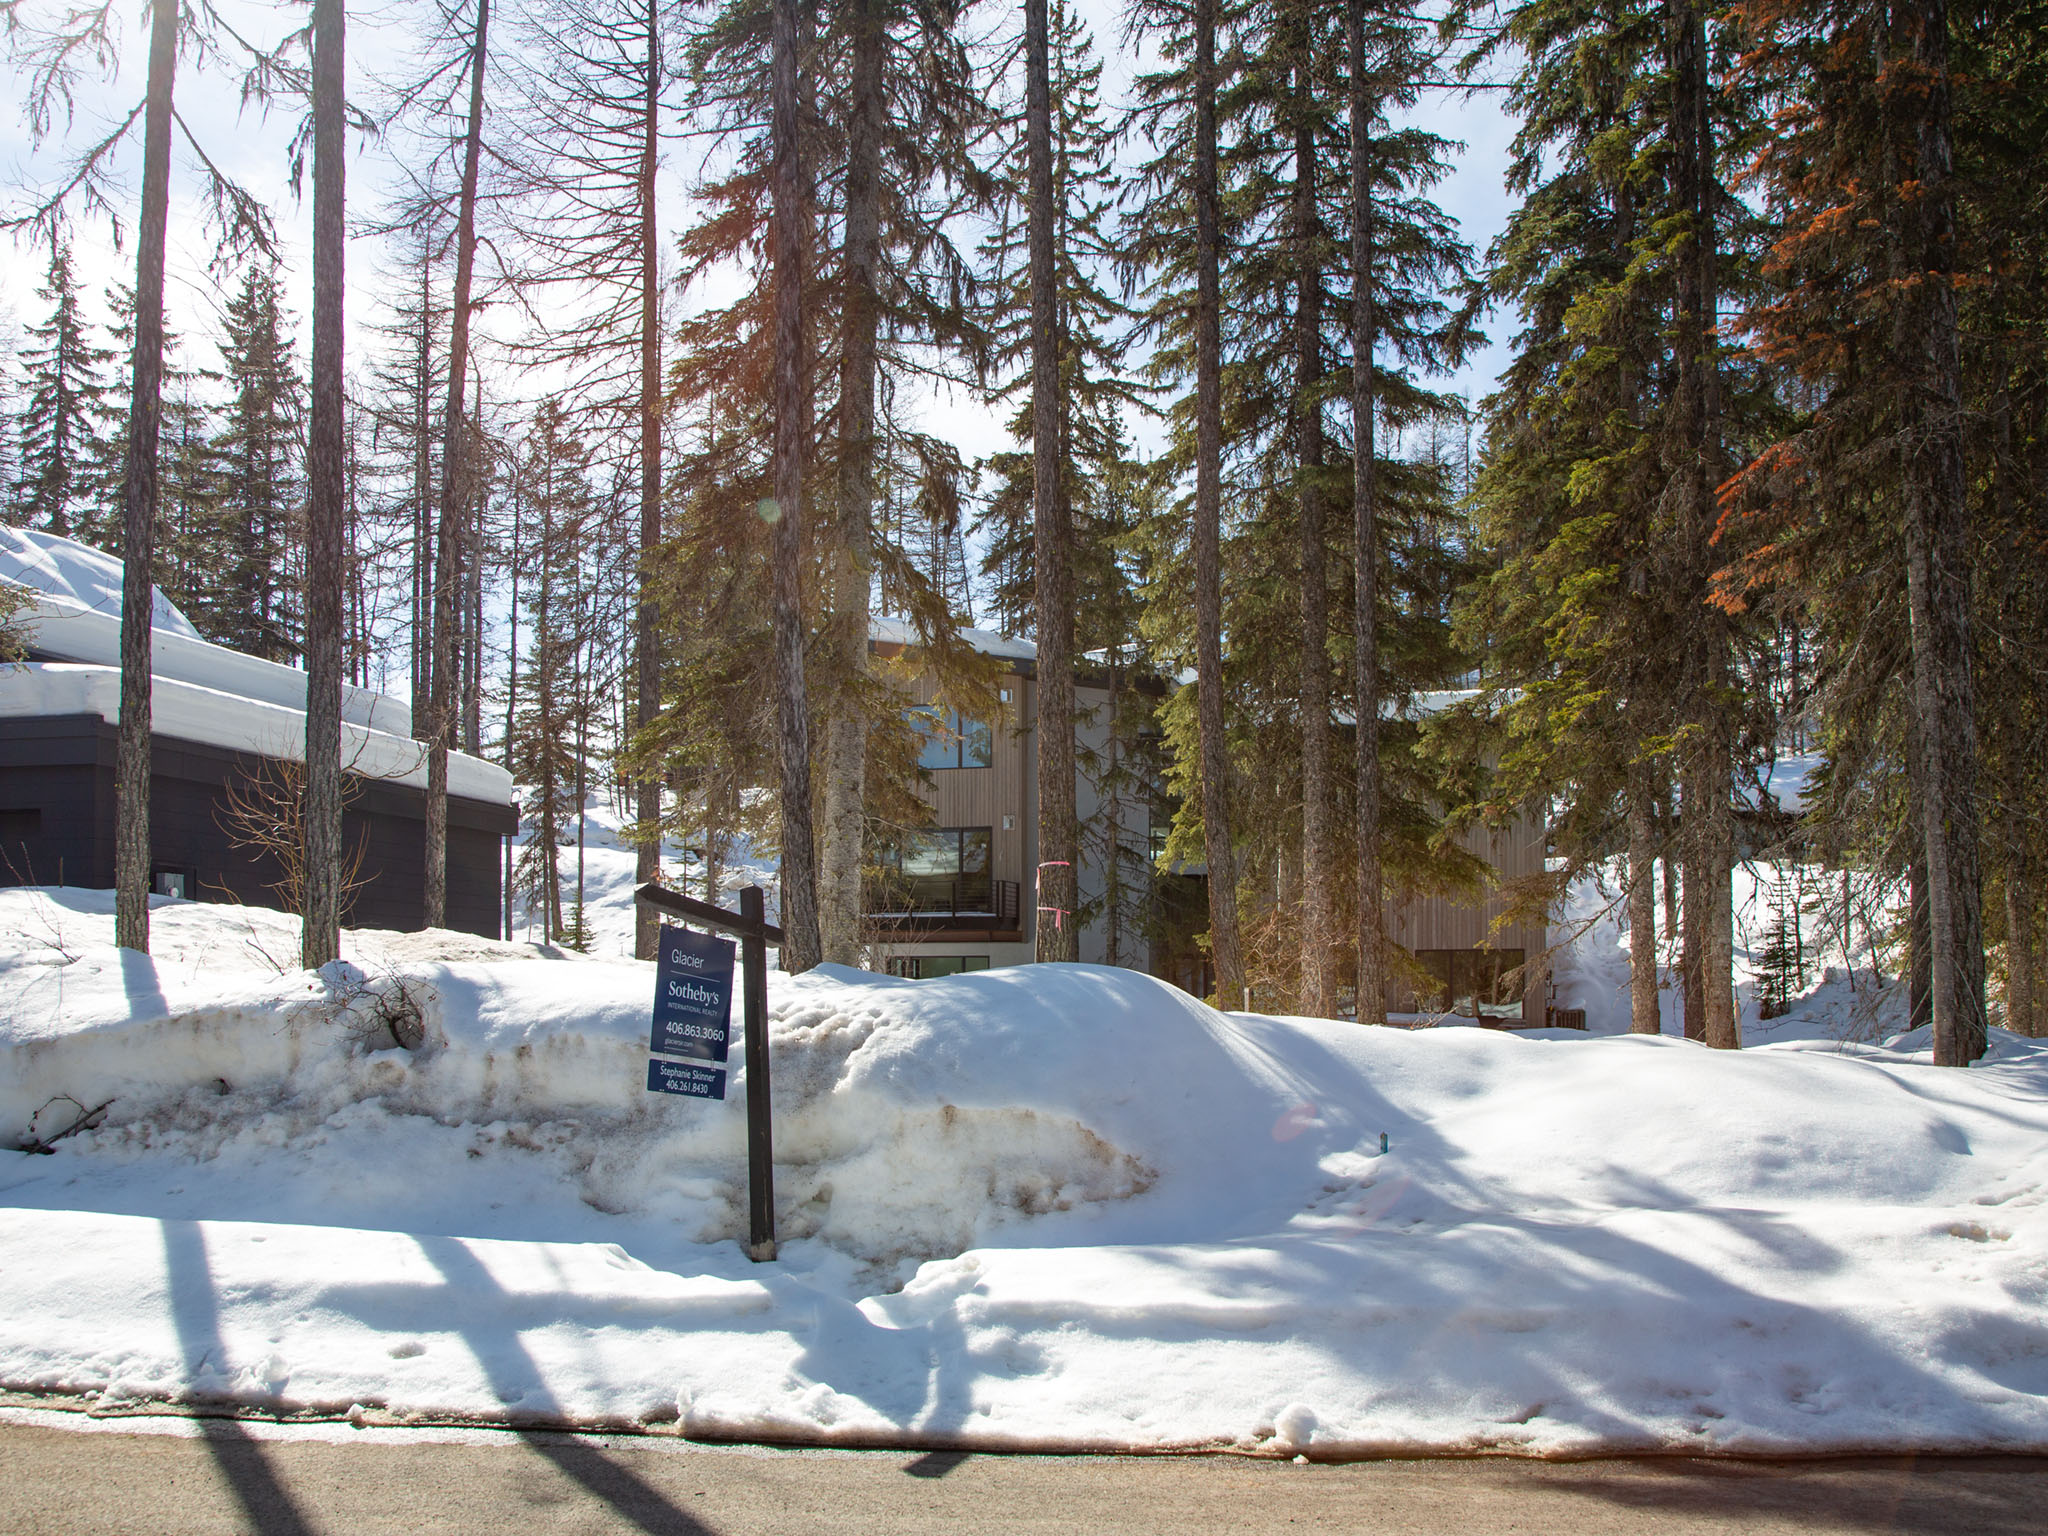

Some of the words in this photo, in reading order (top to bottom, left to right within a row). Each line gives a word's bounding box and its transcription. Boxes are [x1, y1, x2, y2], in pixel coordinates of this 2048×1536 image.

[671, 948, 704, 968] Glacier
[668, 980, 719, 1006] Sotheby's
[667, 1002, 701, 1014] INTERNATIONAL
[702, 1007, 718, 1016] REALTY
[666, 1021, 724, 1041] 406.863.3060
[660, 1065, 691, 1079] Stephanie
[692, 1070, 716, 1082] Skinner
[666, 1080, 708, 1094] 406.261.8430
